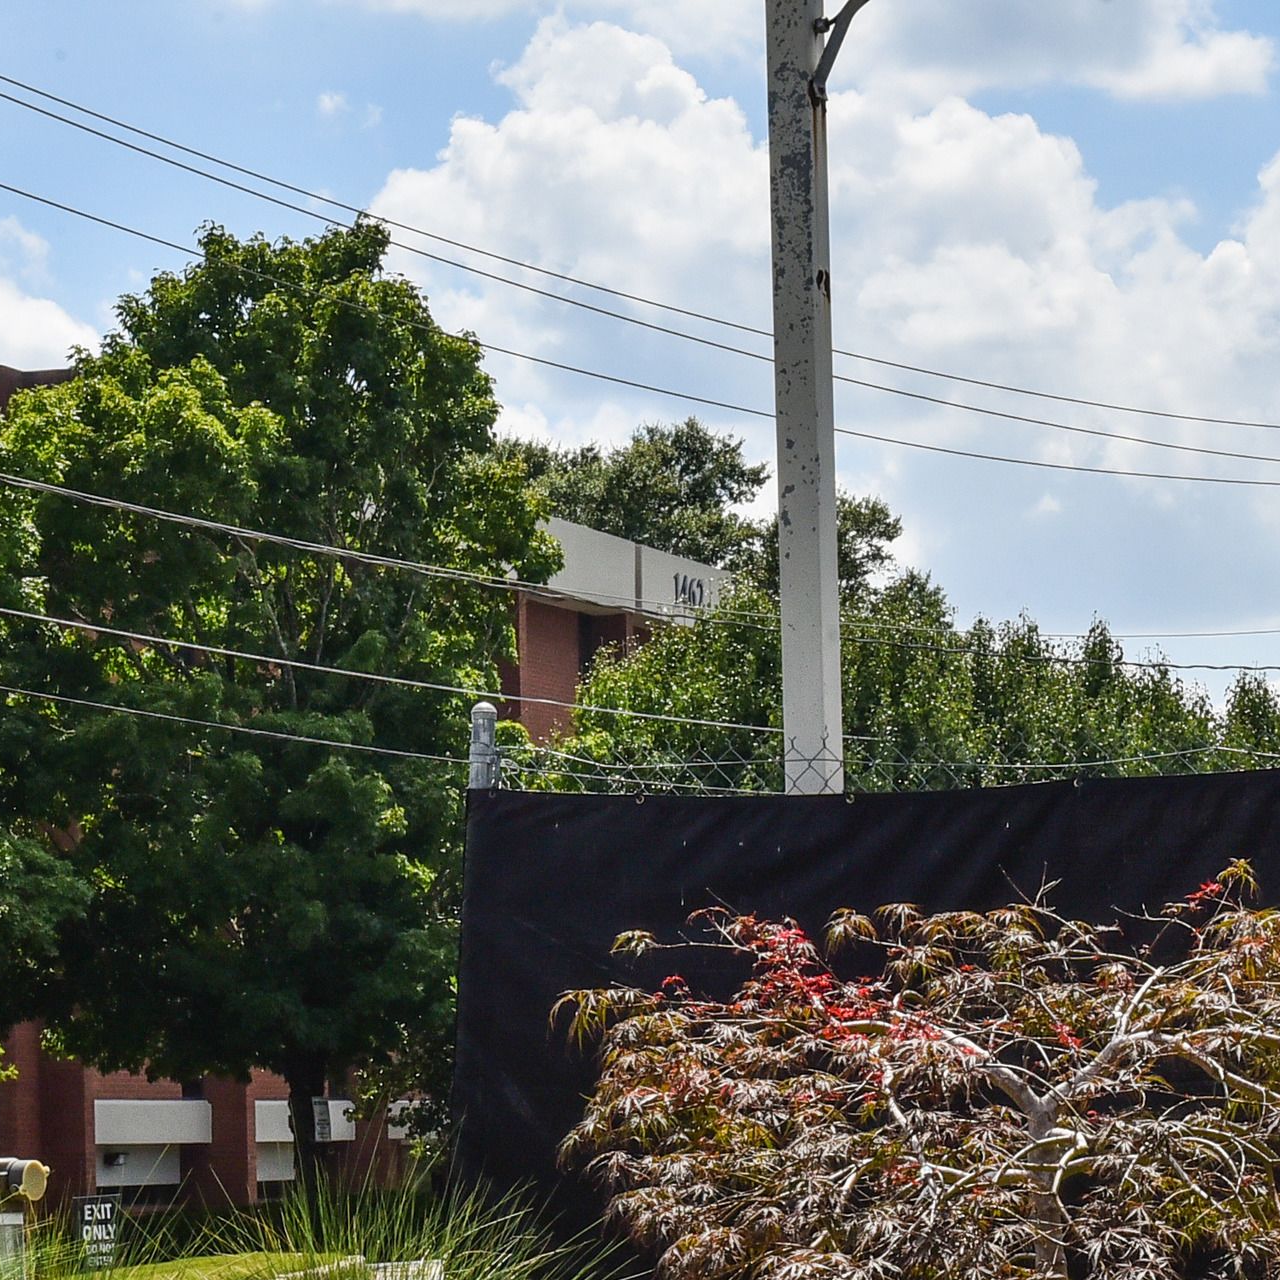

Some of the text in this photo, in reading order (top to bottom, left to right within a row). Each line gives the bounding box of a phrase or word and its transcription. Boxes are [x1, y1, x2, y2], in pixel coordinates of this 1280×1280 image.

[673, 573, 704, 606] 1462
[84, 1203, 112, 1220] EXIT
[83, 1224, 116, 1240] ONLY
